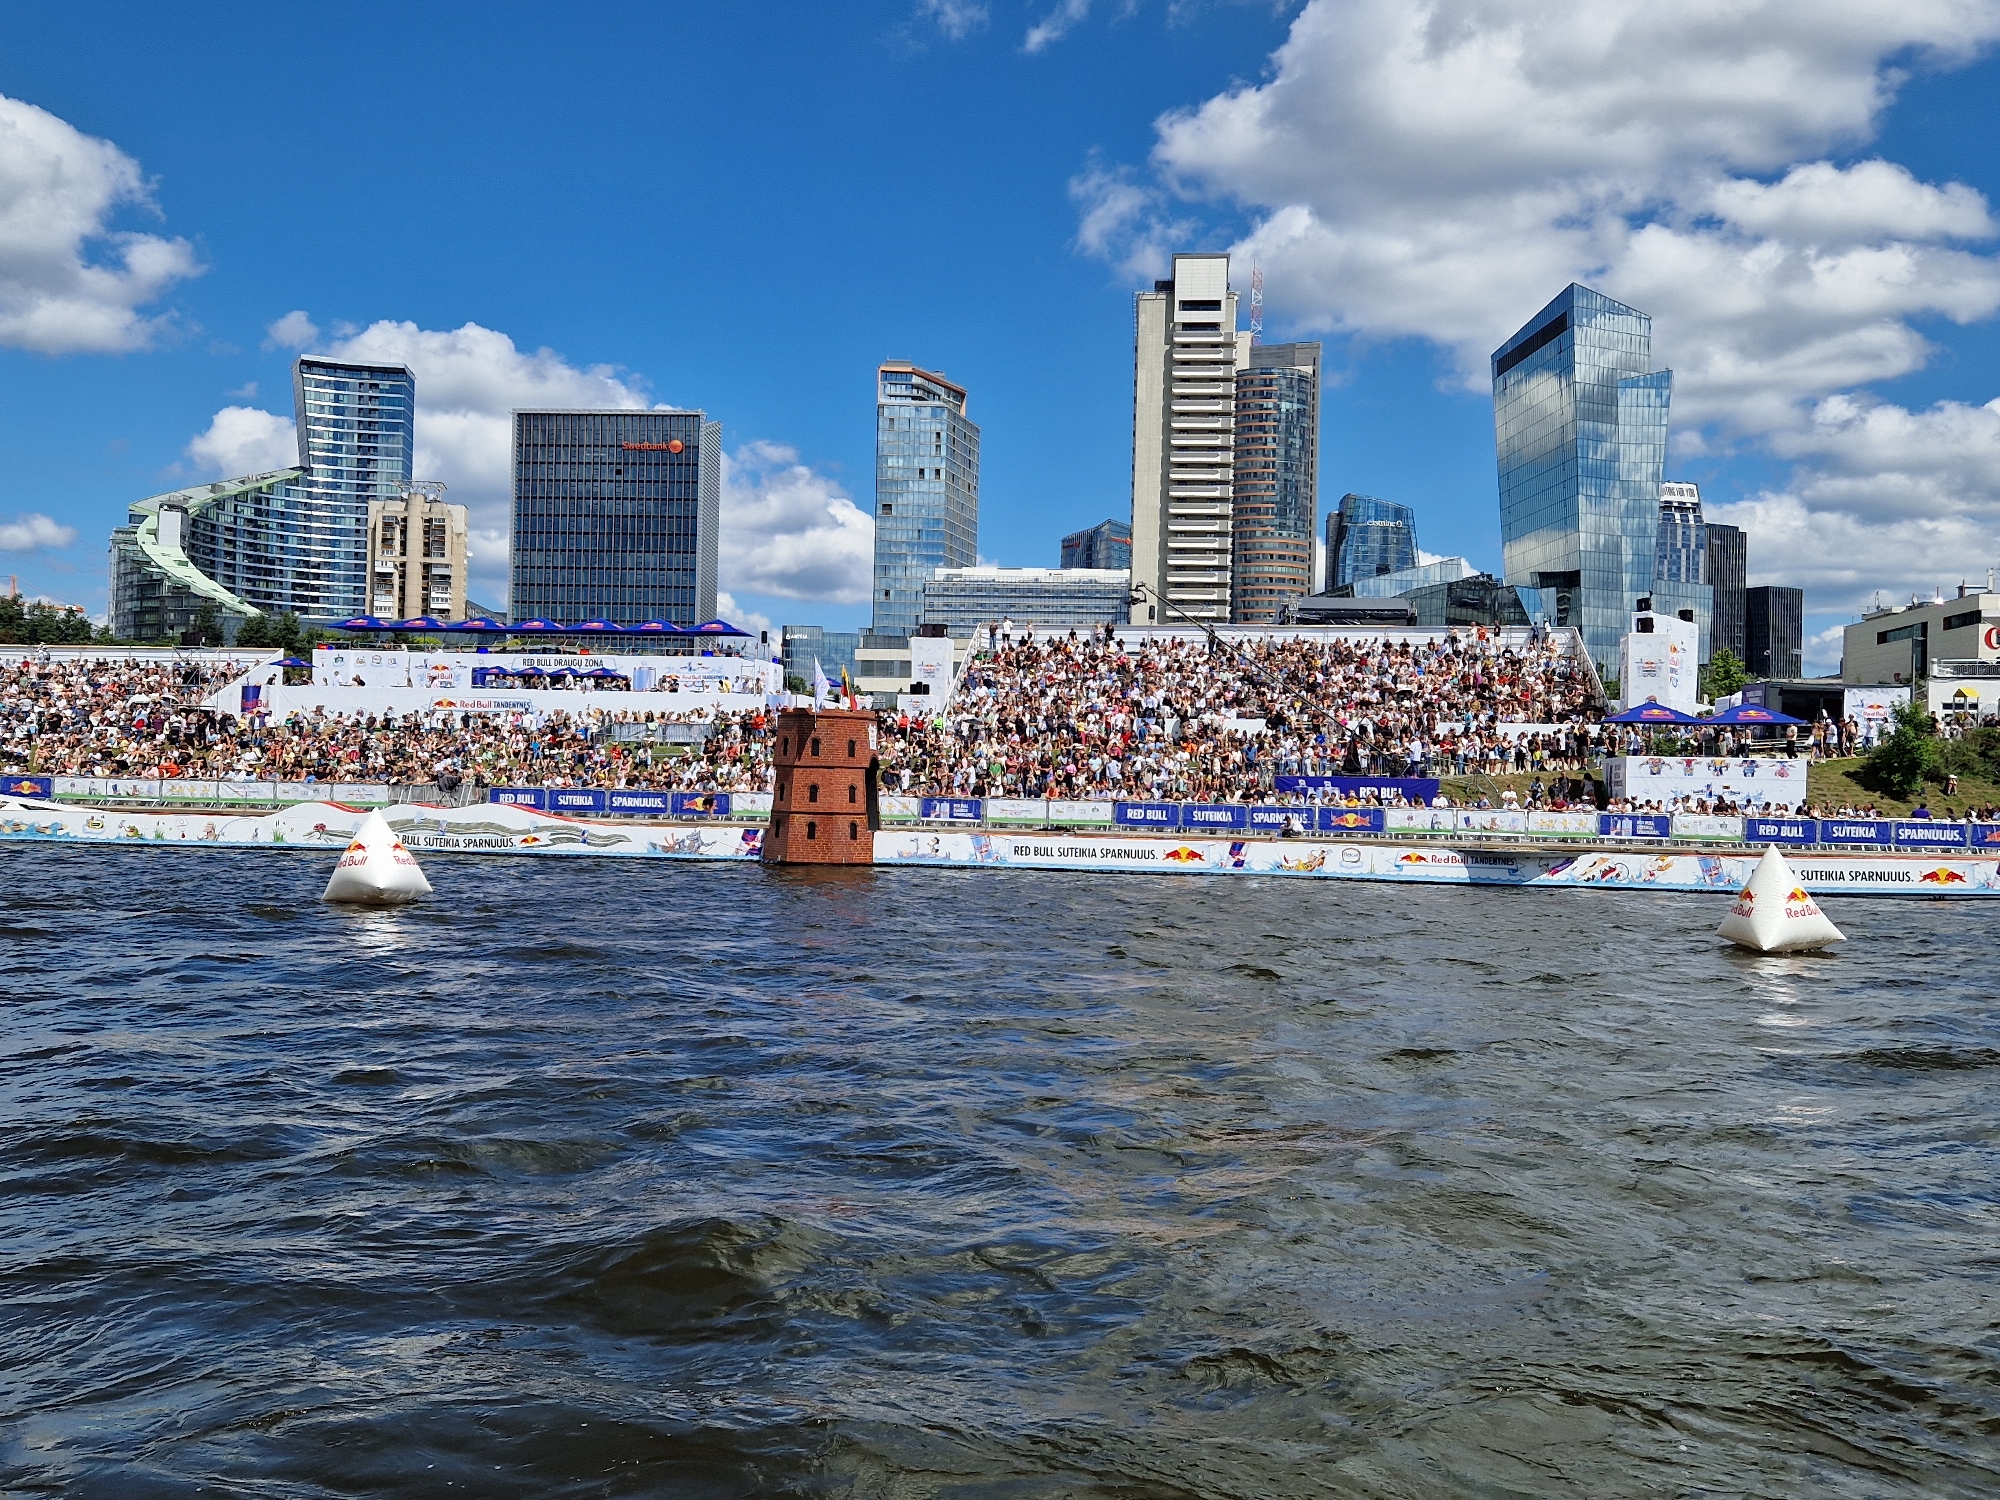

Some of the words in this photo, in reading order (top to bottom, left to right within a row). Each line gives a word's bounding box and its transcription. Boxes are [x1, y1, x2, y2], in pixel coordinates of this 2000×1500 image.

[622, 440, 668, 450] Swedbank
[522, 658, 535, 667] RED
[536, 658, 552, 667] BULL
[584, 658, 604, 668] ZONA
[440, 672, 453, 680] Bull
[460, 700, 476, 709] Red
[476, 700, 492, 709] Bull
[500, 793, 515, 804] RED
[516, 793, 536, 805] BULL
[557, 795, 593, 806] SUTEIKIA
[612, 796, 665, 808] SPARNUUUS.
[1127, 808, 1145, 820] RED
[1146, 809, 1168, 821] BULL
[1192, 810, 1233, 822] SUTEIKIA
[1758, 824, 1779, 836] RED
[1780, 825, 1805, 838] BULL
[1832, 825, 1876, 838] SUTEIKIA
[1898, 828, 1964, 842] SPARNUUUS.
[401, 834, 421, 846] BULL
[423, 836, 461, 848] SUTEIKIA
[462, 837, 517, 849] SPARNUUUS.
[1013, 845, 1031, 857] RED
[1033, 846, 1055, 857] BULL
[1057, 846, 1098, 859] SUTEIKIA
[1100, 847, 1159, 860] SPARNUUUS.
[348, 856, 368, 866] Bull
[1431, 854, 1450, 864] Red
[1451, 854, 1469, 865] Bull
[1800, 869, 1846, 882] SUTEIKIA
[1848, 870, 1915, 883] SPARNUUUS.
[1739, 904, 1754, 919] Bull
[1784, 904, 1806, 919] Red
